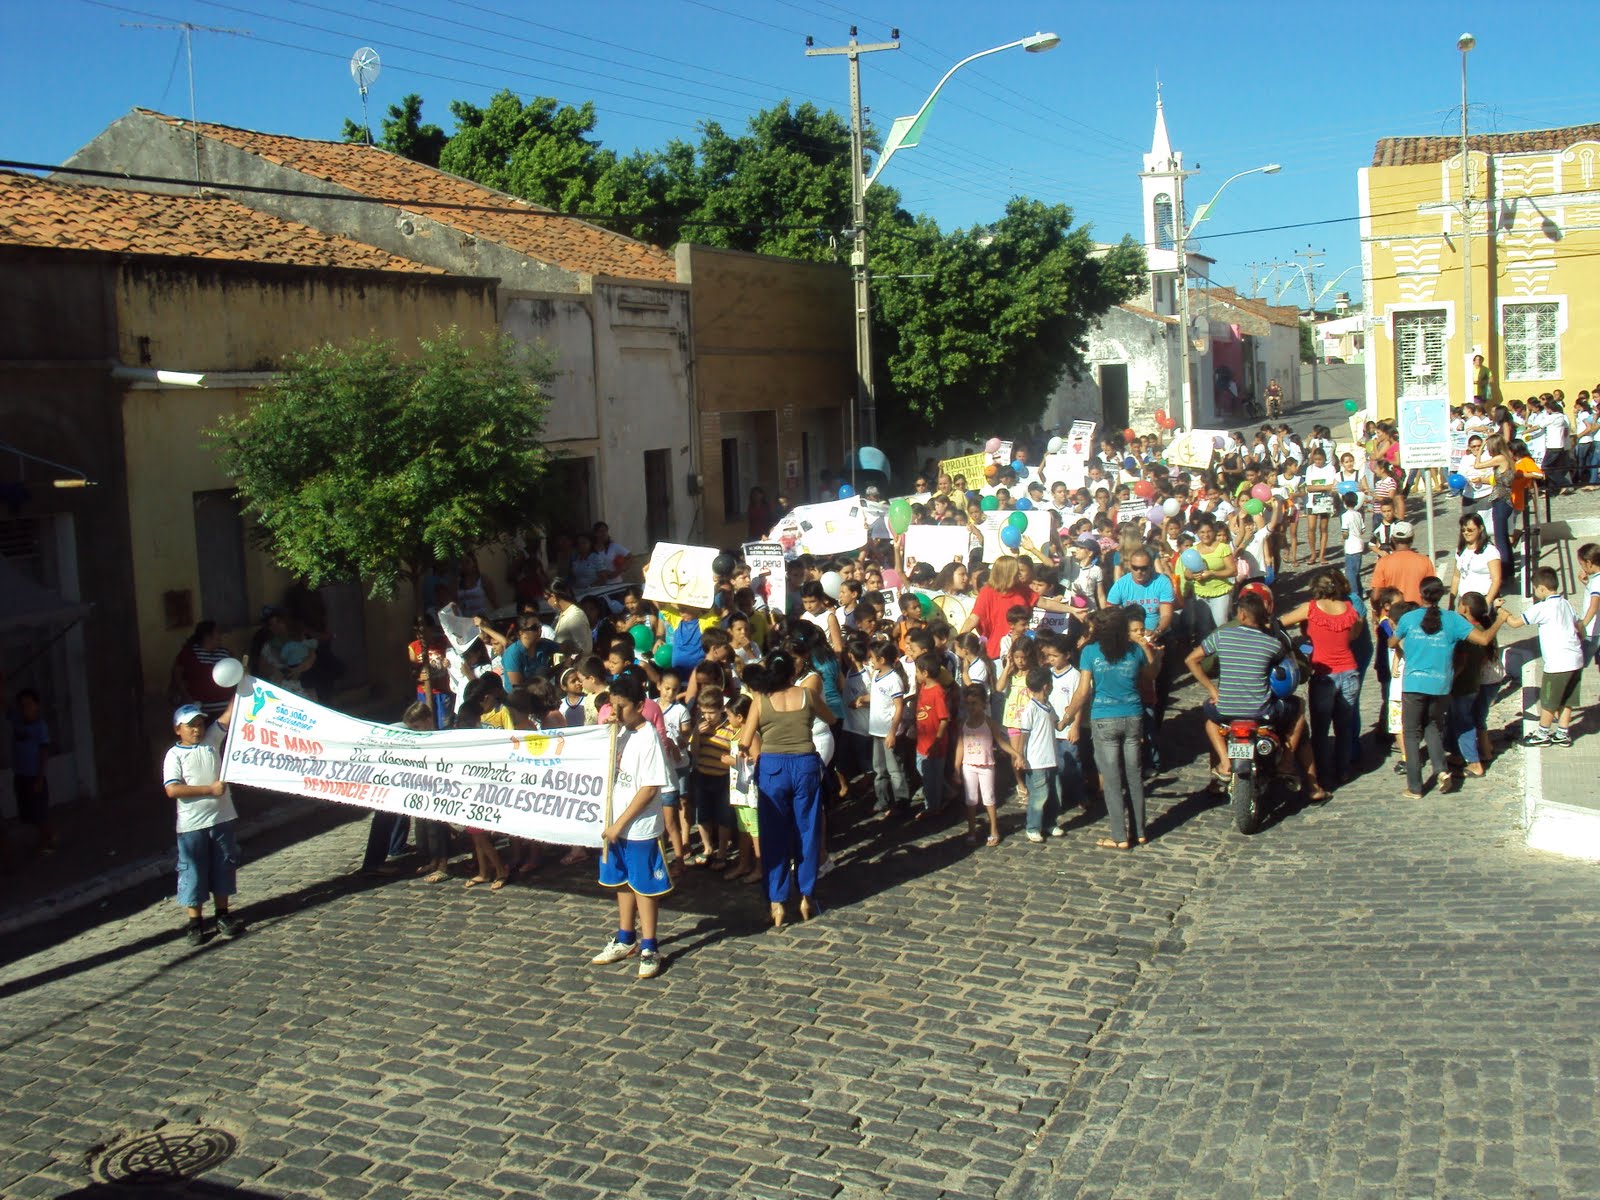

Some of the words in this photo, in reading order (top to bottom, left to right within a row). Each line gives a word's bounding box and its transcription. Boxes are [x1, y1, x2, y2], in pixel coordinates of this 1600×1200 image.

[753, 558, 761, 568] da
[763, 560, 781, 569] pena
[241, 722, 256, 742] 18
[260, 727, 280, 749] DE
[284, 734, 324, 755] MAIO
[509, 752, 562, 767] TUTELAR
[231, 750, 242, 762] e
[241, 747, 327, 777] EXPLORAÇÃO
[325, 760, 375, 784] SEXUAL
[372, 769, 390, 786] de
[390, 771, 463, 798] CRIANÇAS
[461, 787, 472, 800] e
[378, 750, 428, 770] Nacional
[436, 757, 454, 774] de
[461, 761, 516, 783] combate
[520, 772, 538, 785] ao
[541, 769, 604, 797] ABUSO
[403, 792, 430, 812] (88)
